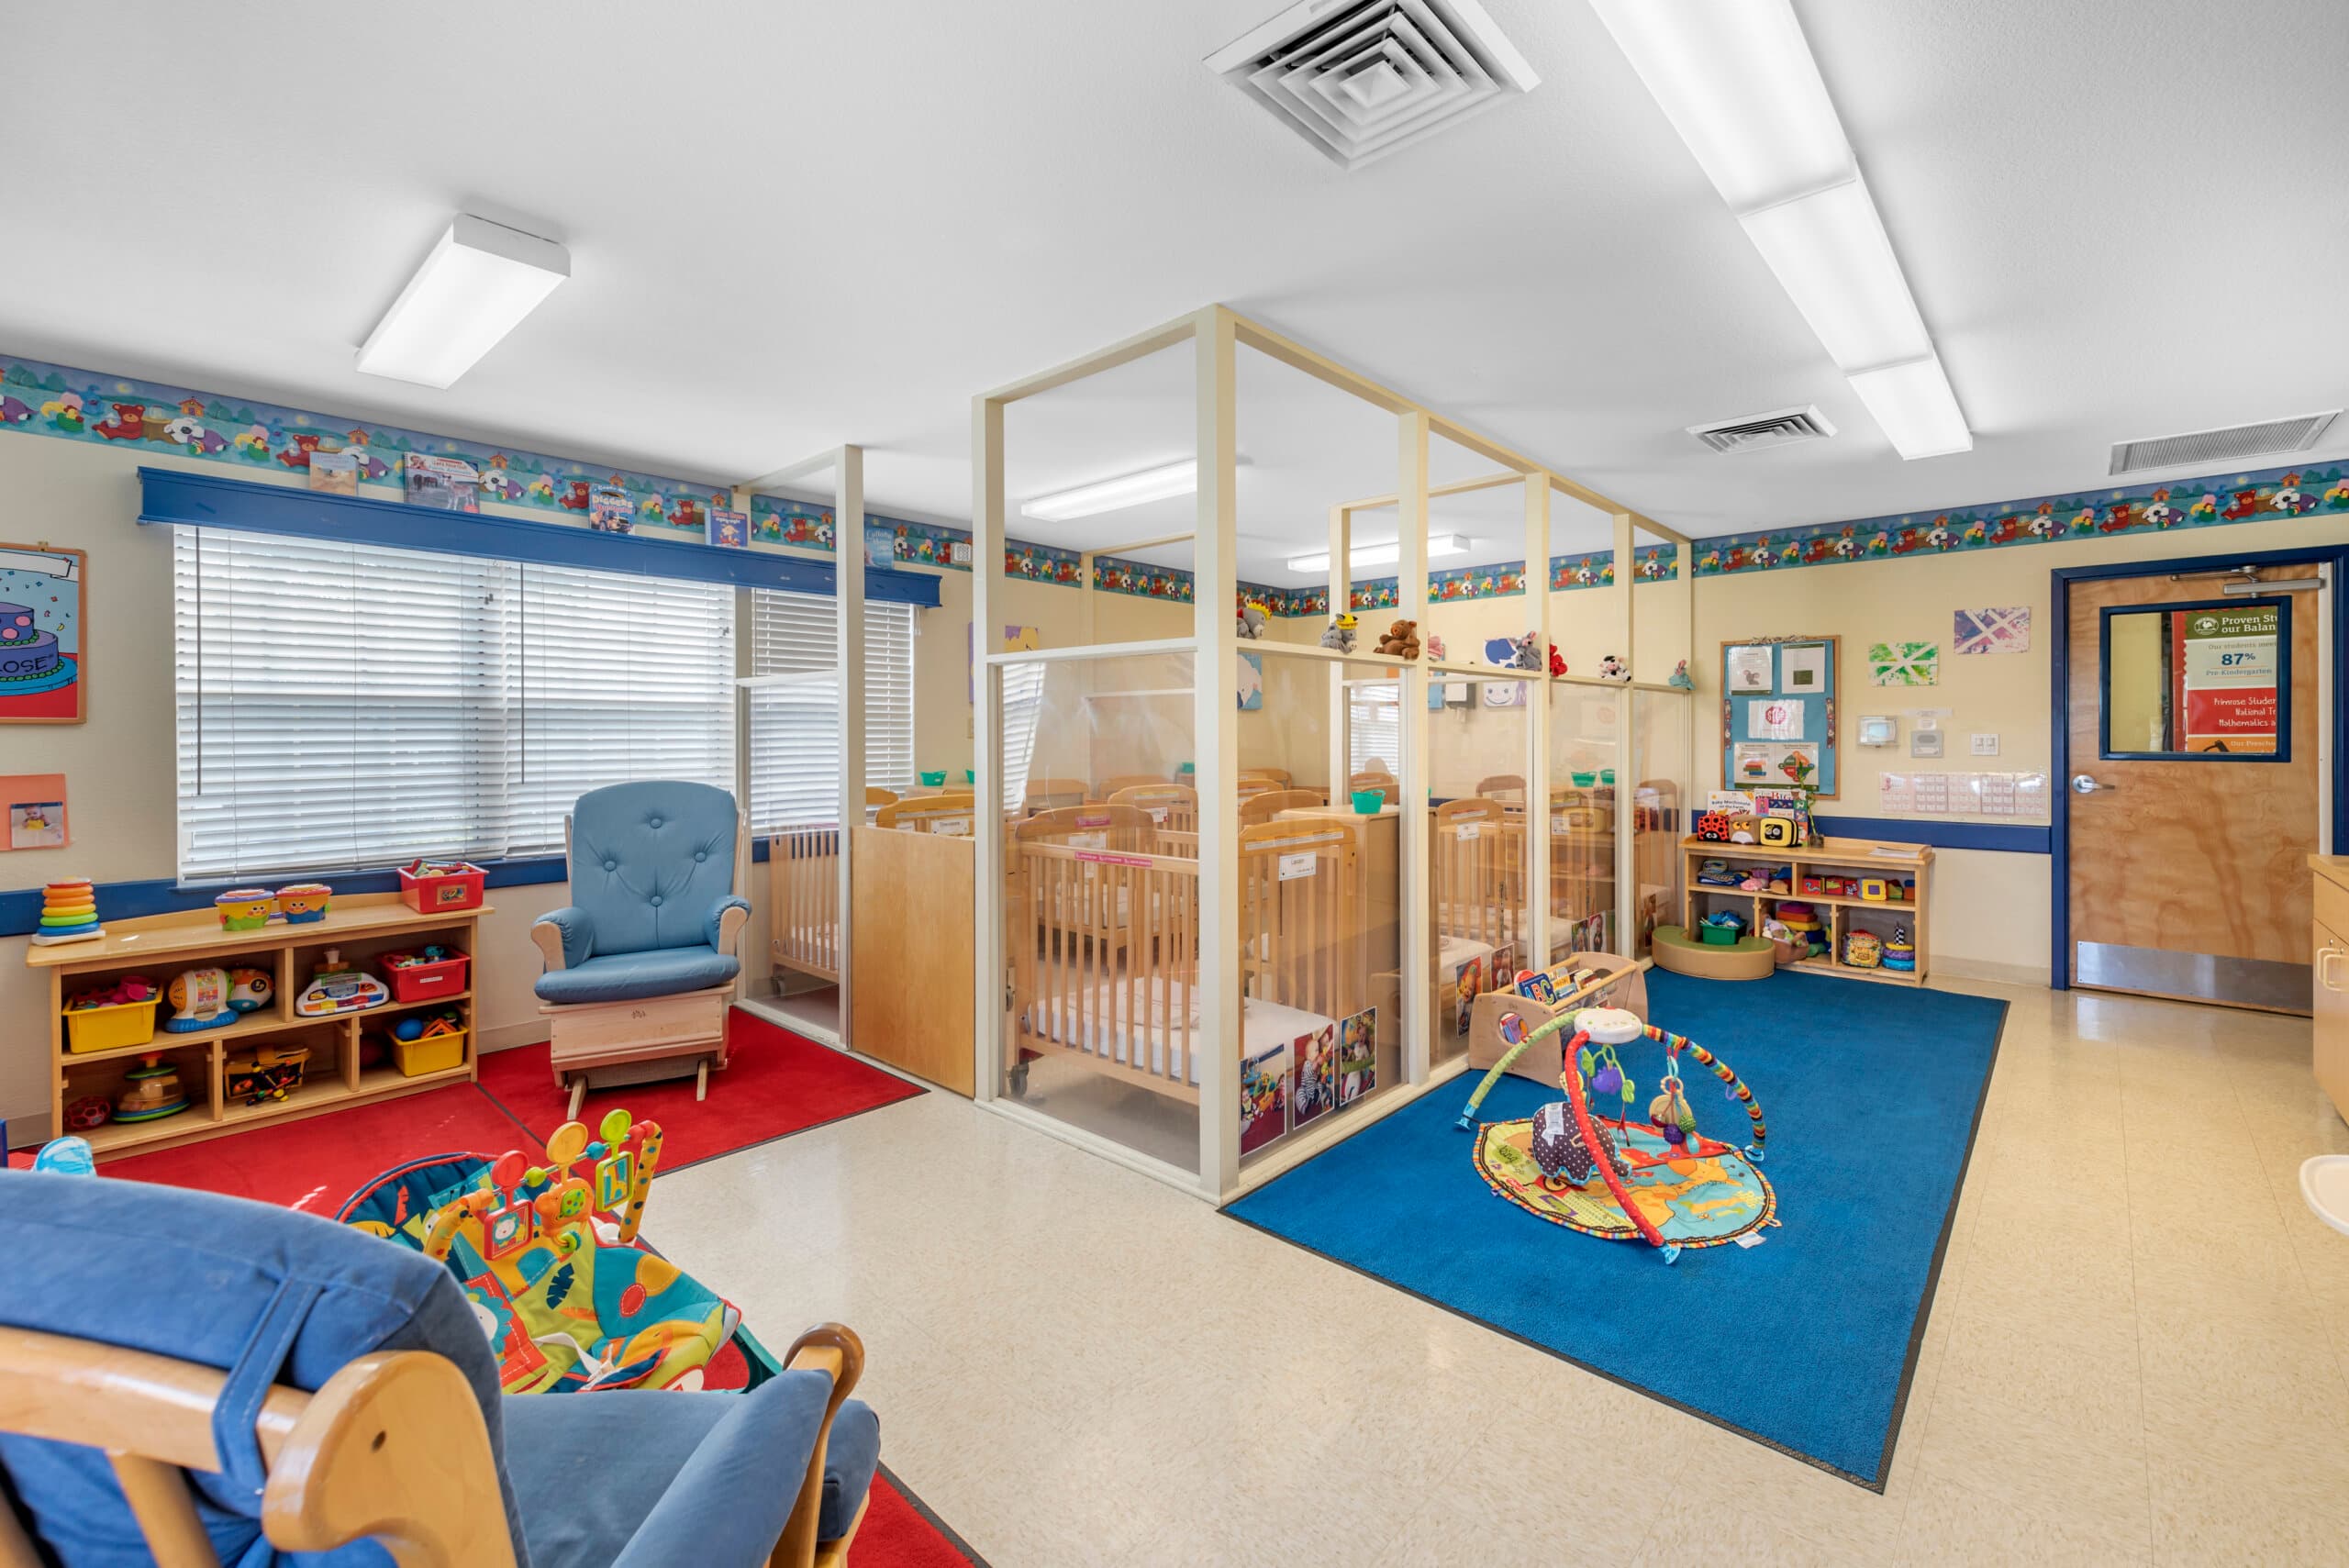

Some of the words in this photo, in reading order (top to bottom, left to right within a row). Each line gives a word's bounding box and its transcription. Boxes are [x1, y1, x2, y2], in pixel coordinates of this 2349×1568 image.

[2221, 617, 2260, 625] Proven
[2243, 624, 2276, 632] Balan
[2221, 653, 2256, 665] 87%
[0, 656, 48, 673] OSE
[2213, 697, 2246, 706] Primrose
[2235, 707, 2266, 716] National
[2219, 718, 2268, 727] Mathematics
[1525, 979, 1553, 1004] ABC
